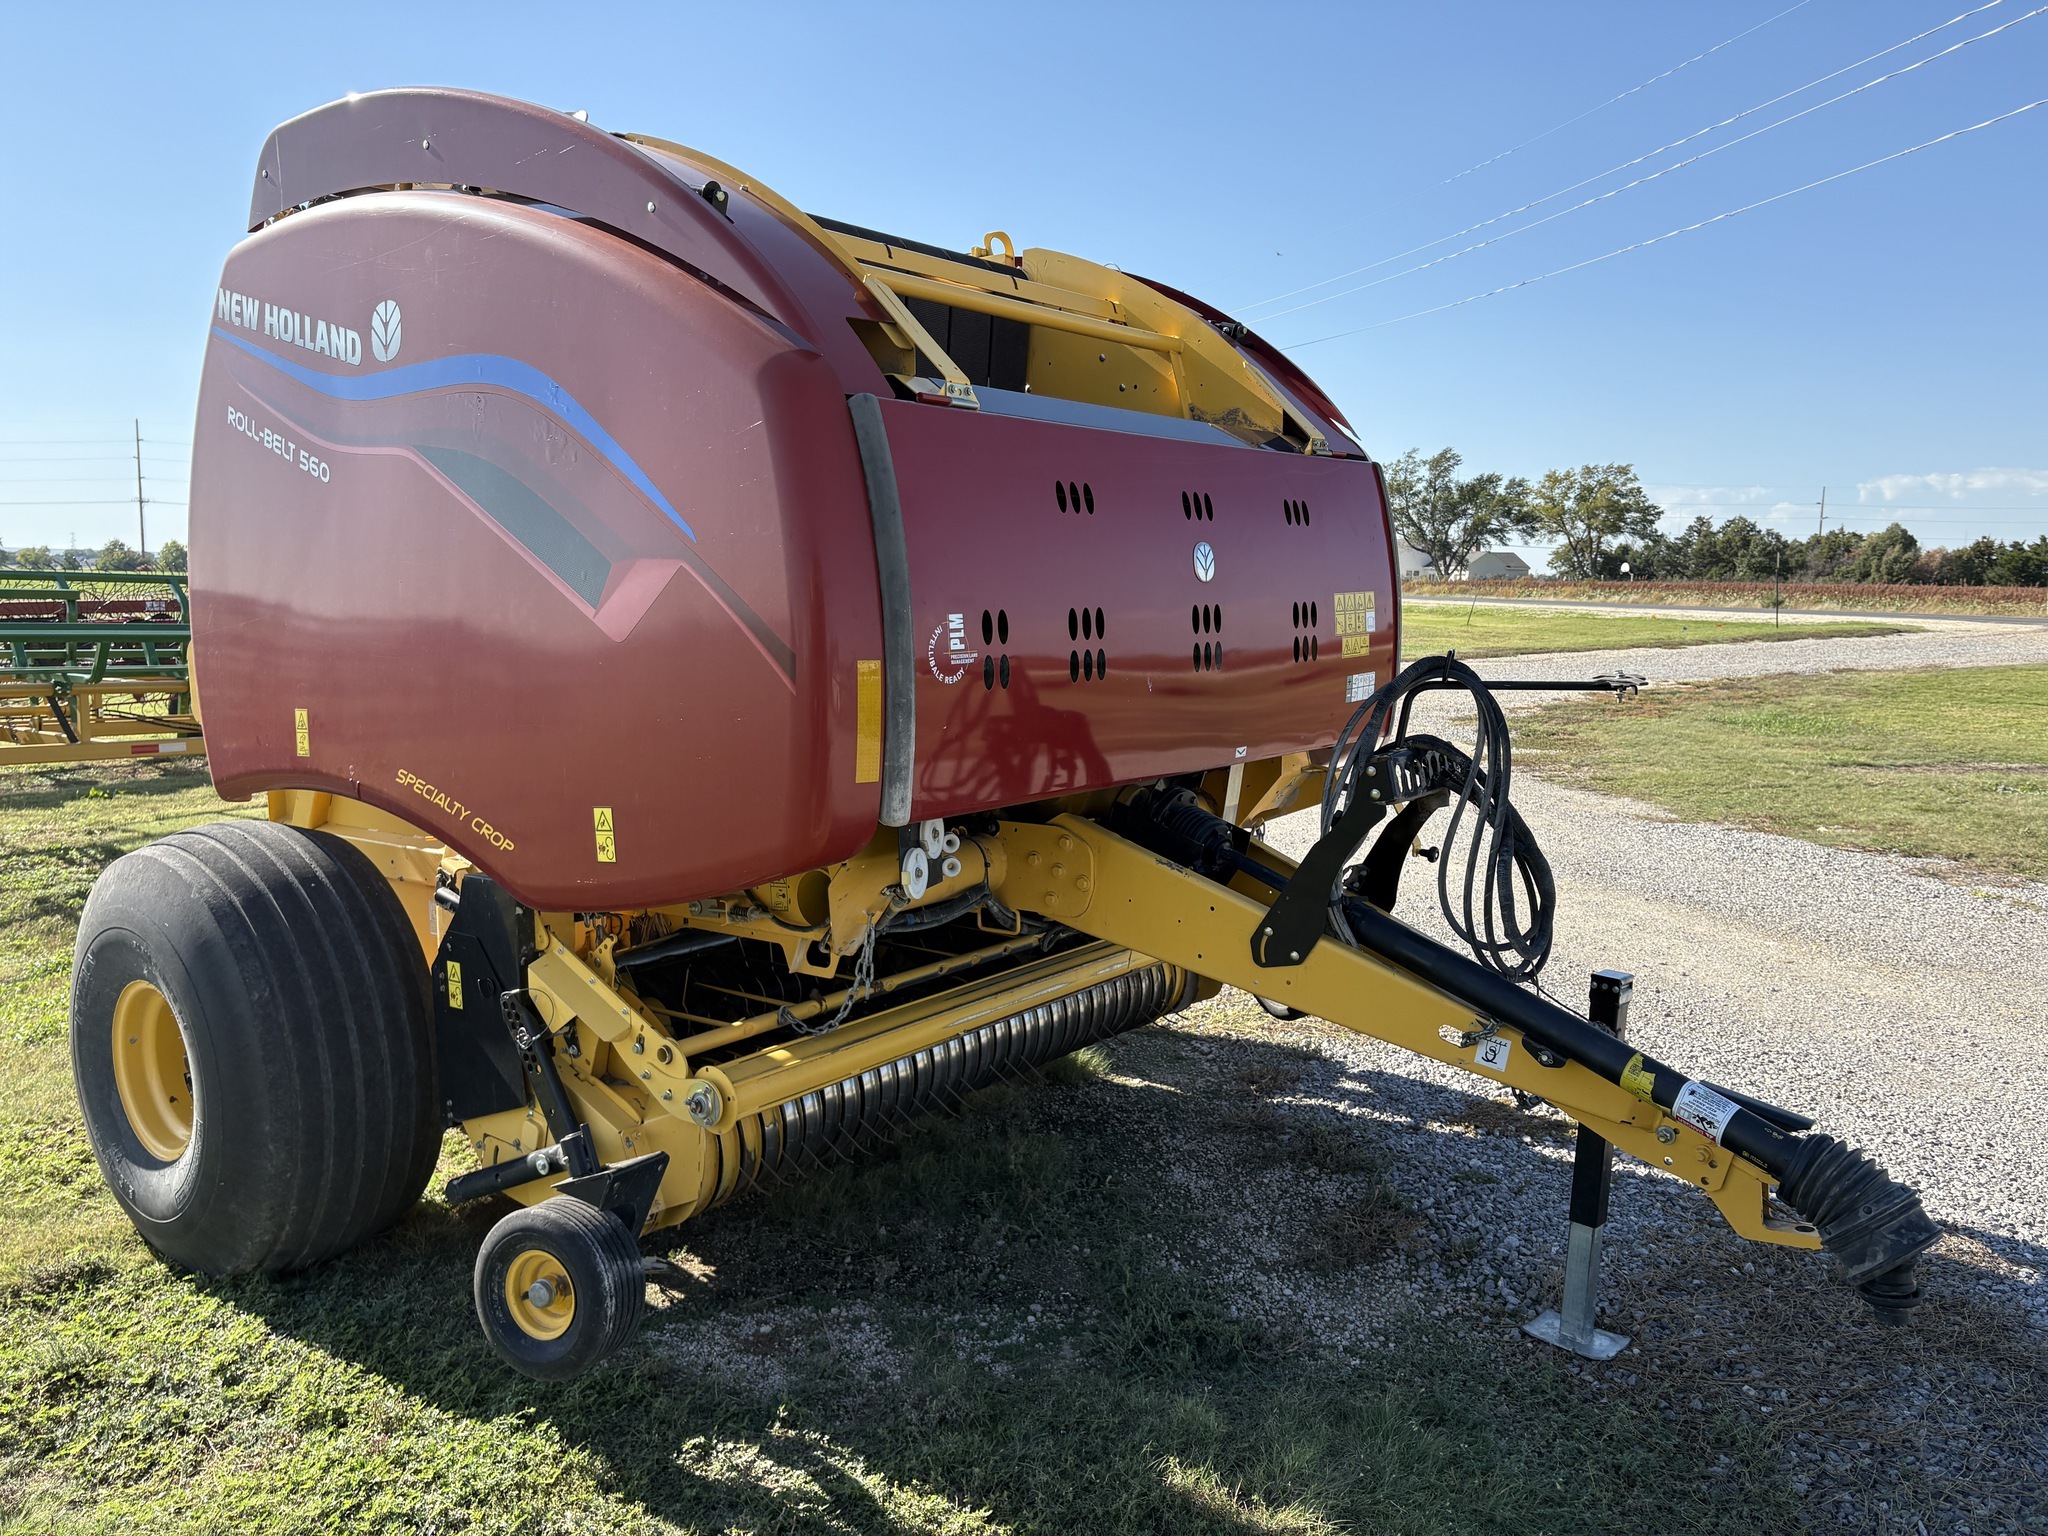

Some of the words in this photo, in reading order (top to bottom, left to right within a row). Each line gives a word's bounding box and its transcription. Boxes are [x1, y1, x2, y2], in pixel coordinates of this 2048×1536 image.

[218, 287, 260, 331] NEW
[264, 303, 362, 366] HOLLAND
[227, 405, 296, 463] ROLL-BELT
[299, 449, 330, 483] 560
[928, 625, 944, 682] INTELLIBALE
[944, 667, 965, 684] READY
[948, 613, 965, 650] PLM
[395, 769, 471, 821] SPECIALTY
[471, 817, 515, 851] CROP
